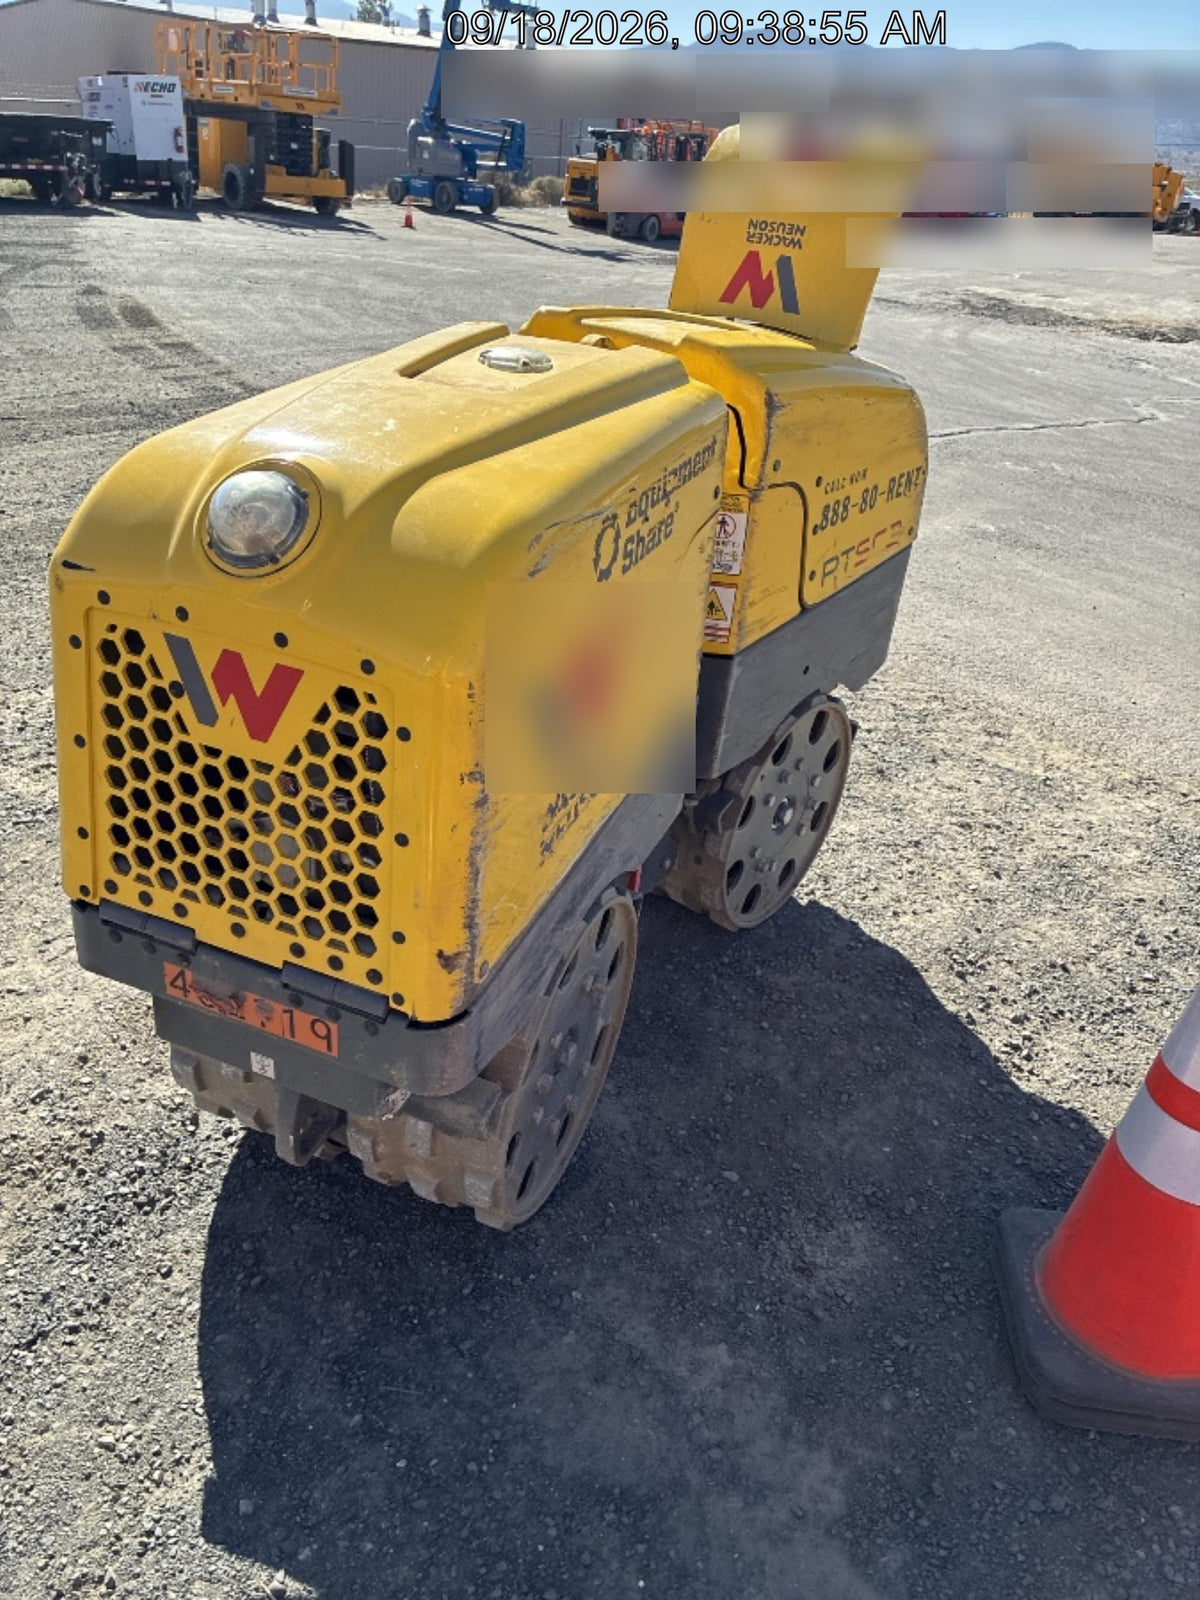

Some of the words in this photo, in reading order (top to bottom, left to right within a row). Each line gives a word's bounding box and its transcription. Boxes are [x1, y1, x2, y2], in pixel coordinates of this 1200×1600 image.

[747, 218, 807, 236] NEUSON
[746, 231, 802, 249] WACKER
[824, 477, 847, 496] CALL
[819, 465, 923, 532] 888-80-RENT
[621, 511, 675, 575] Share
